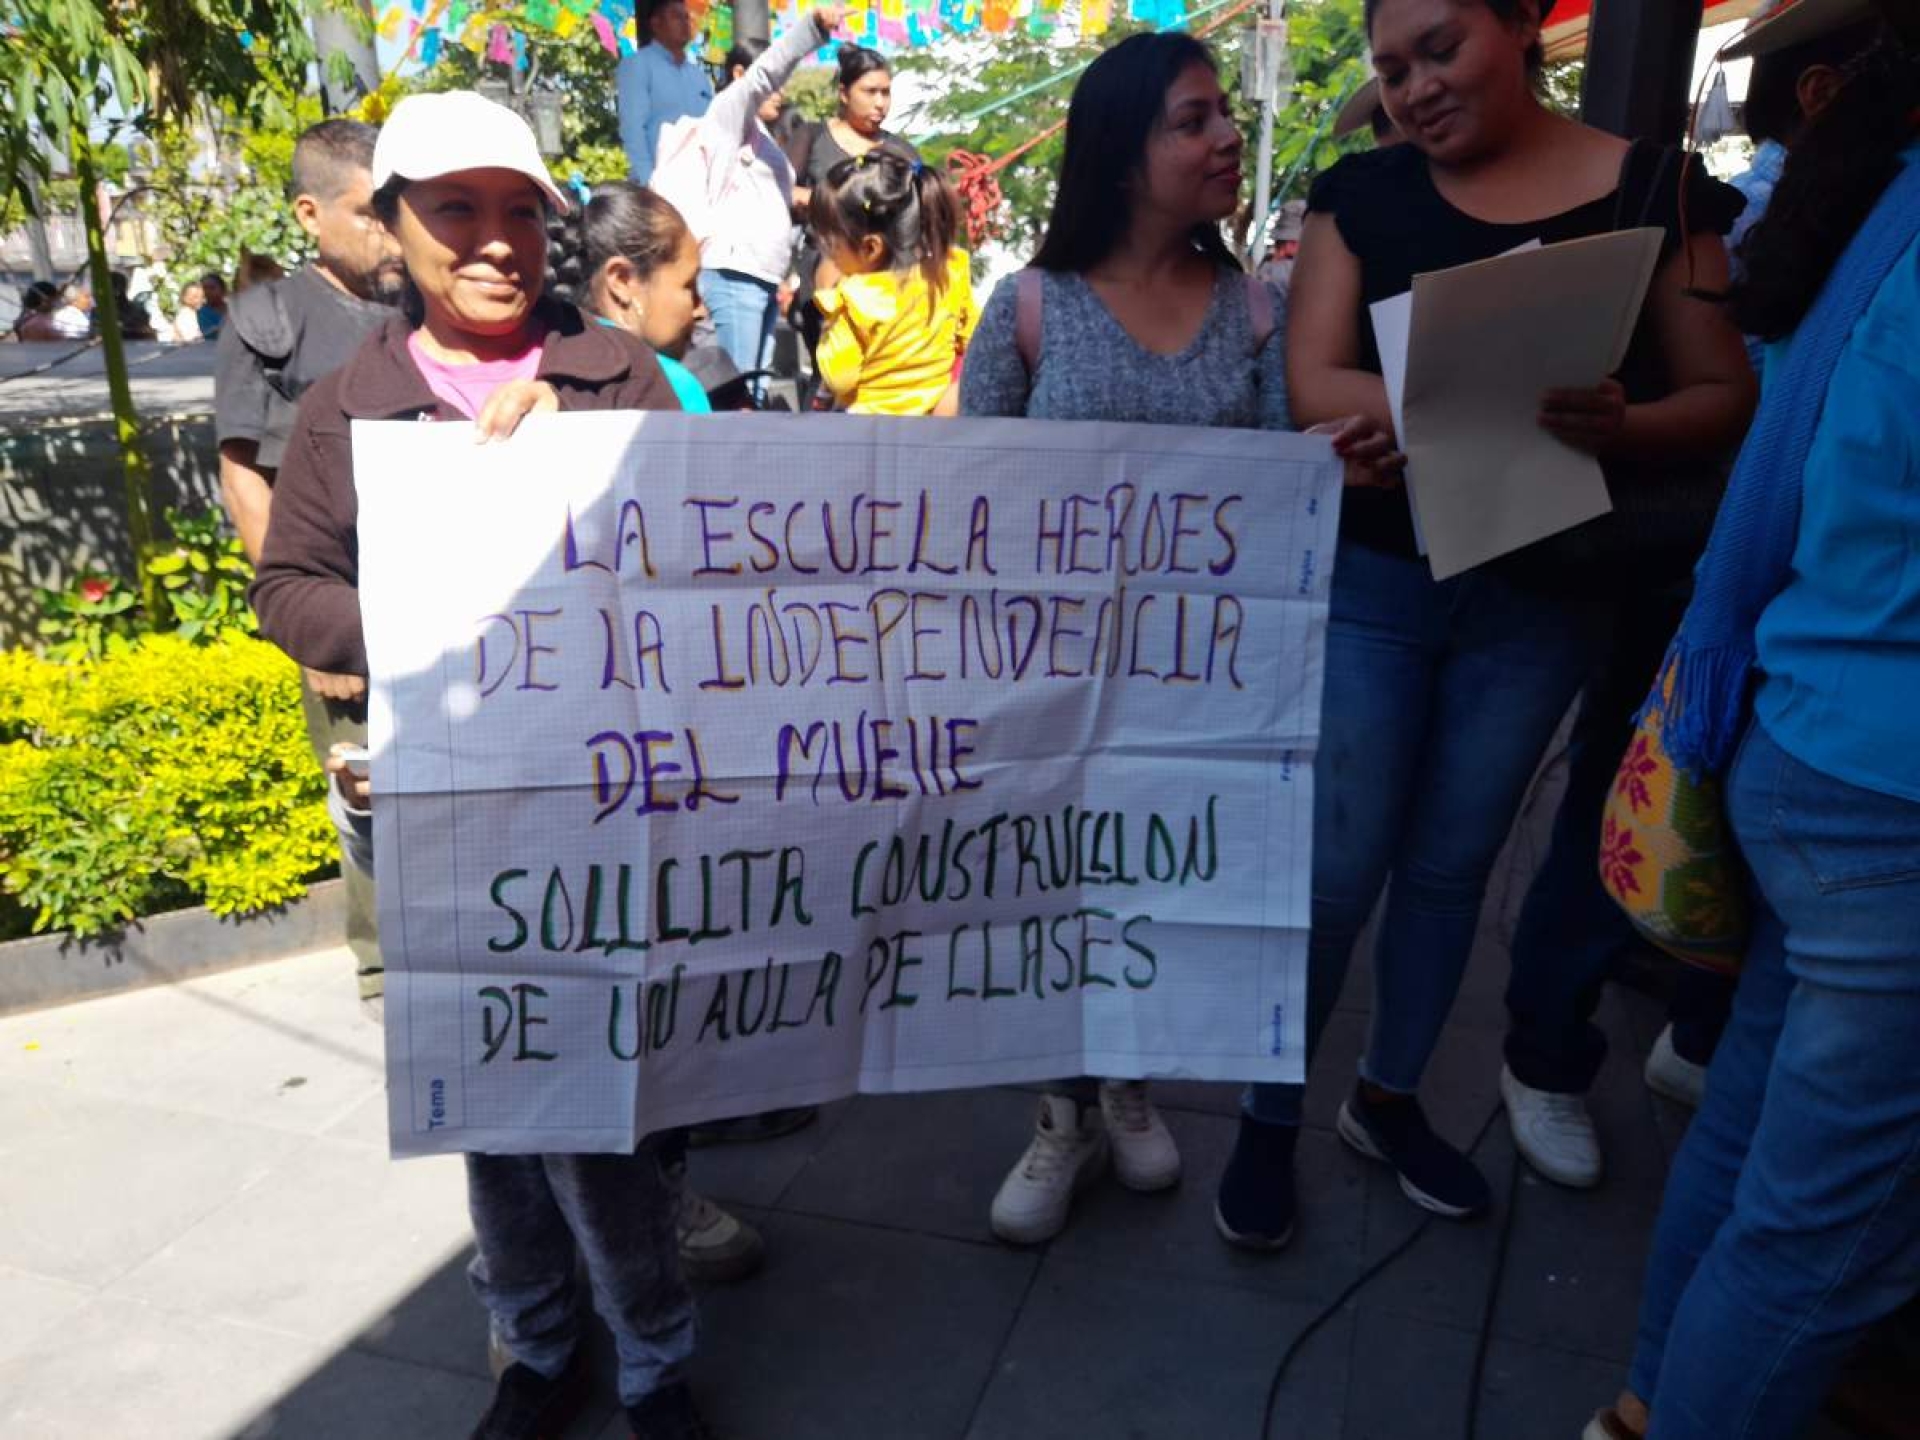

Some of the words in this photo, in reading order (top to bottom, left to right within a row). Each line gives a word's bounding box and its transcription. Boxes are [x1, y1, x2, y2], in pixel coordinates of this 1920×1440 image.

[563, 500, 656, 578] LA
[683, 489, 998, 577] ESCUELA
[1036, 482, 1244, 577] HEROES
[474, 607, 563, 698] DE
[599, 609, 671, 693] LA
[699, 587, 1244, 692] INDEPENDENCIA
[586, 727, 740, 824] DEL
[487, 846, 814, 956] SOLICITA
[851, 794, 1218, 919] CONSTRUCCION
[478, 983, 557, 1064] DE
[608, 963, 687, 1062] UN
[696, 949, 842, 1043] AULA
[859, 931, 922, 1014] DE
[946, 908, 1157, 1001] CLASES
[427, 1078, 446, 1132] Tema
